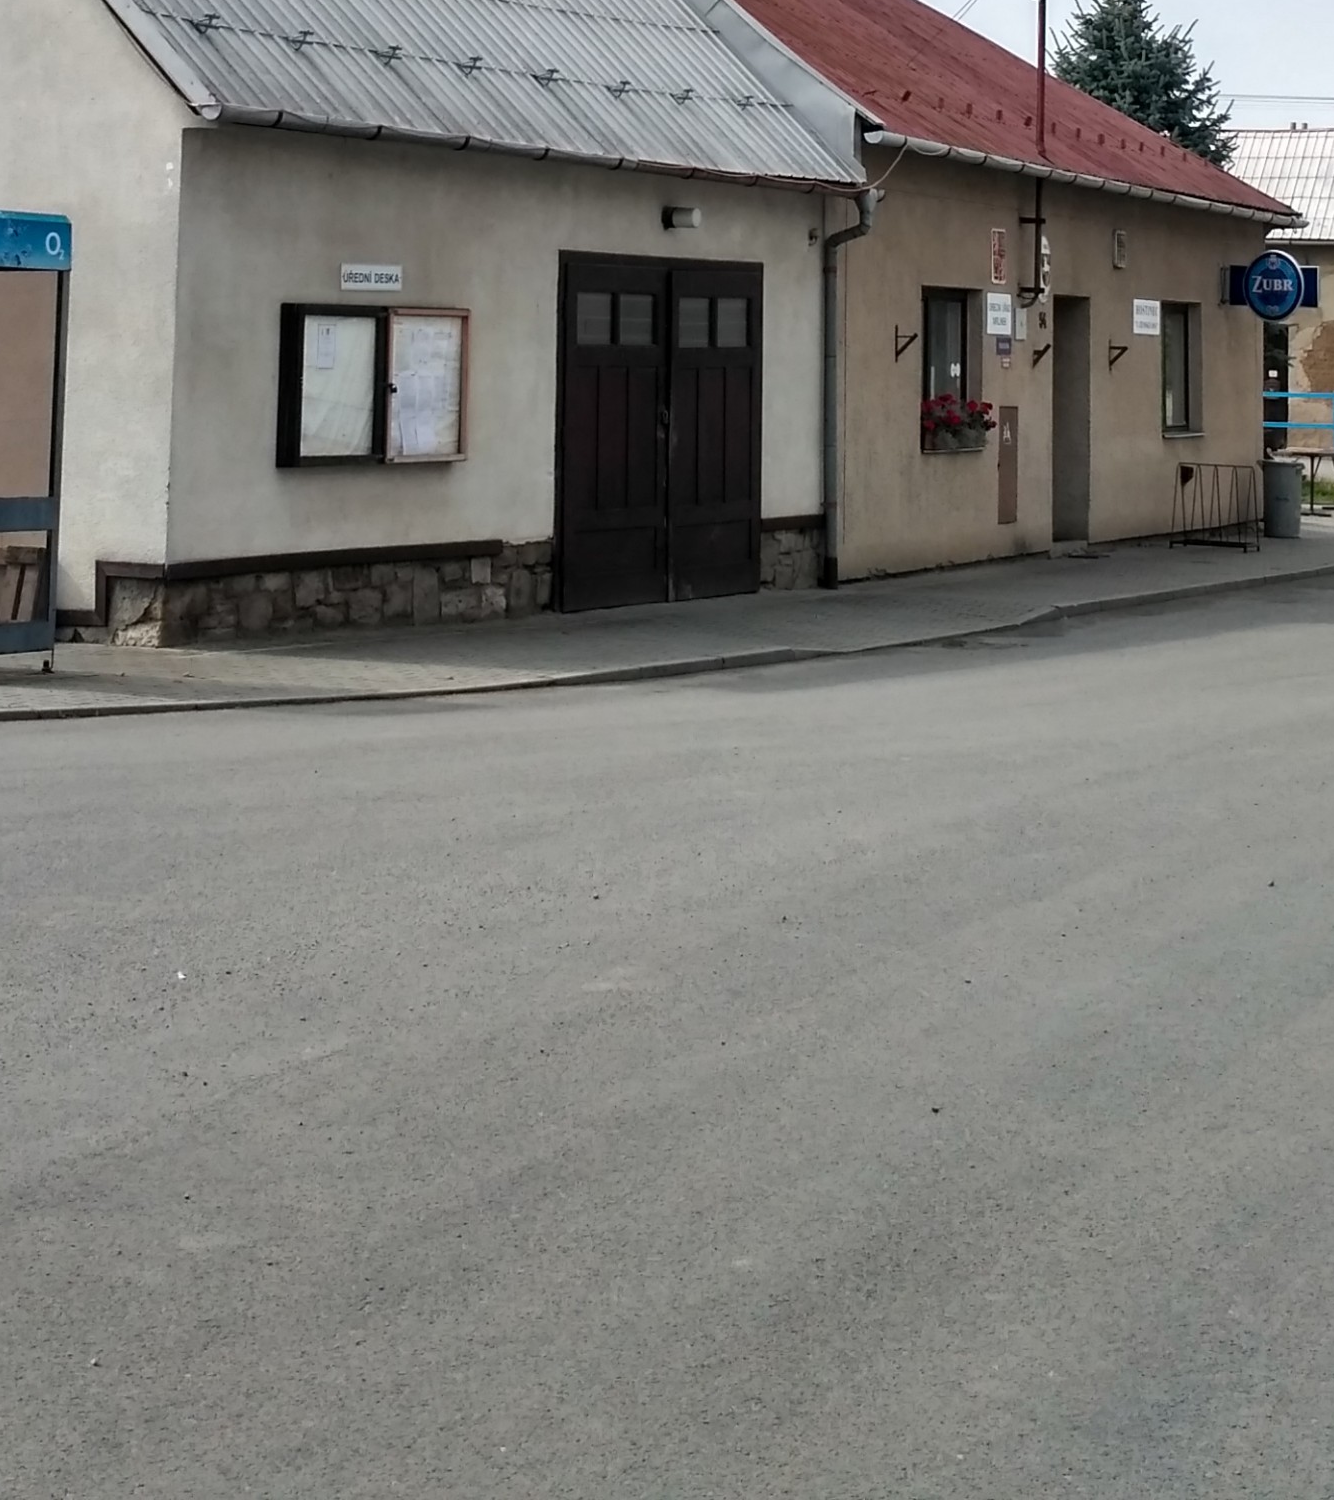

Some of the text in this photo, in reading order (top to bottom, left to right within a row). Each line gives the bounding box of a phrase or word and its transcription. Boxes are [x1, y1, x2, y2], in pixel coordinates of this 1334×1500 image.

[45, 231, 64, 260] O2
[374, 272, 400, 284] DESKA
[1251, 275, 1294, 293] ZUBR
